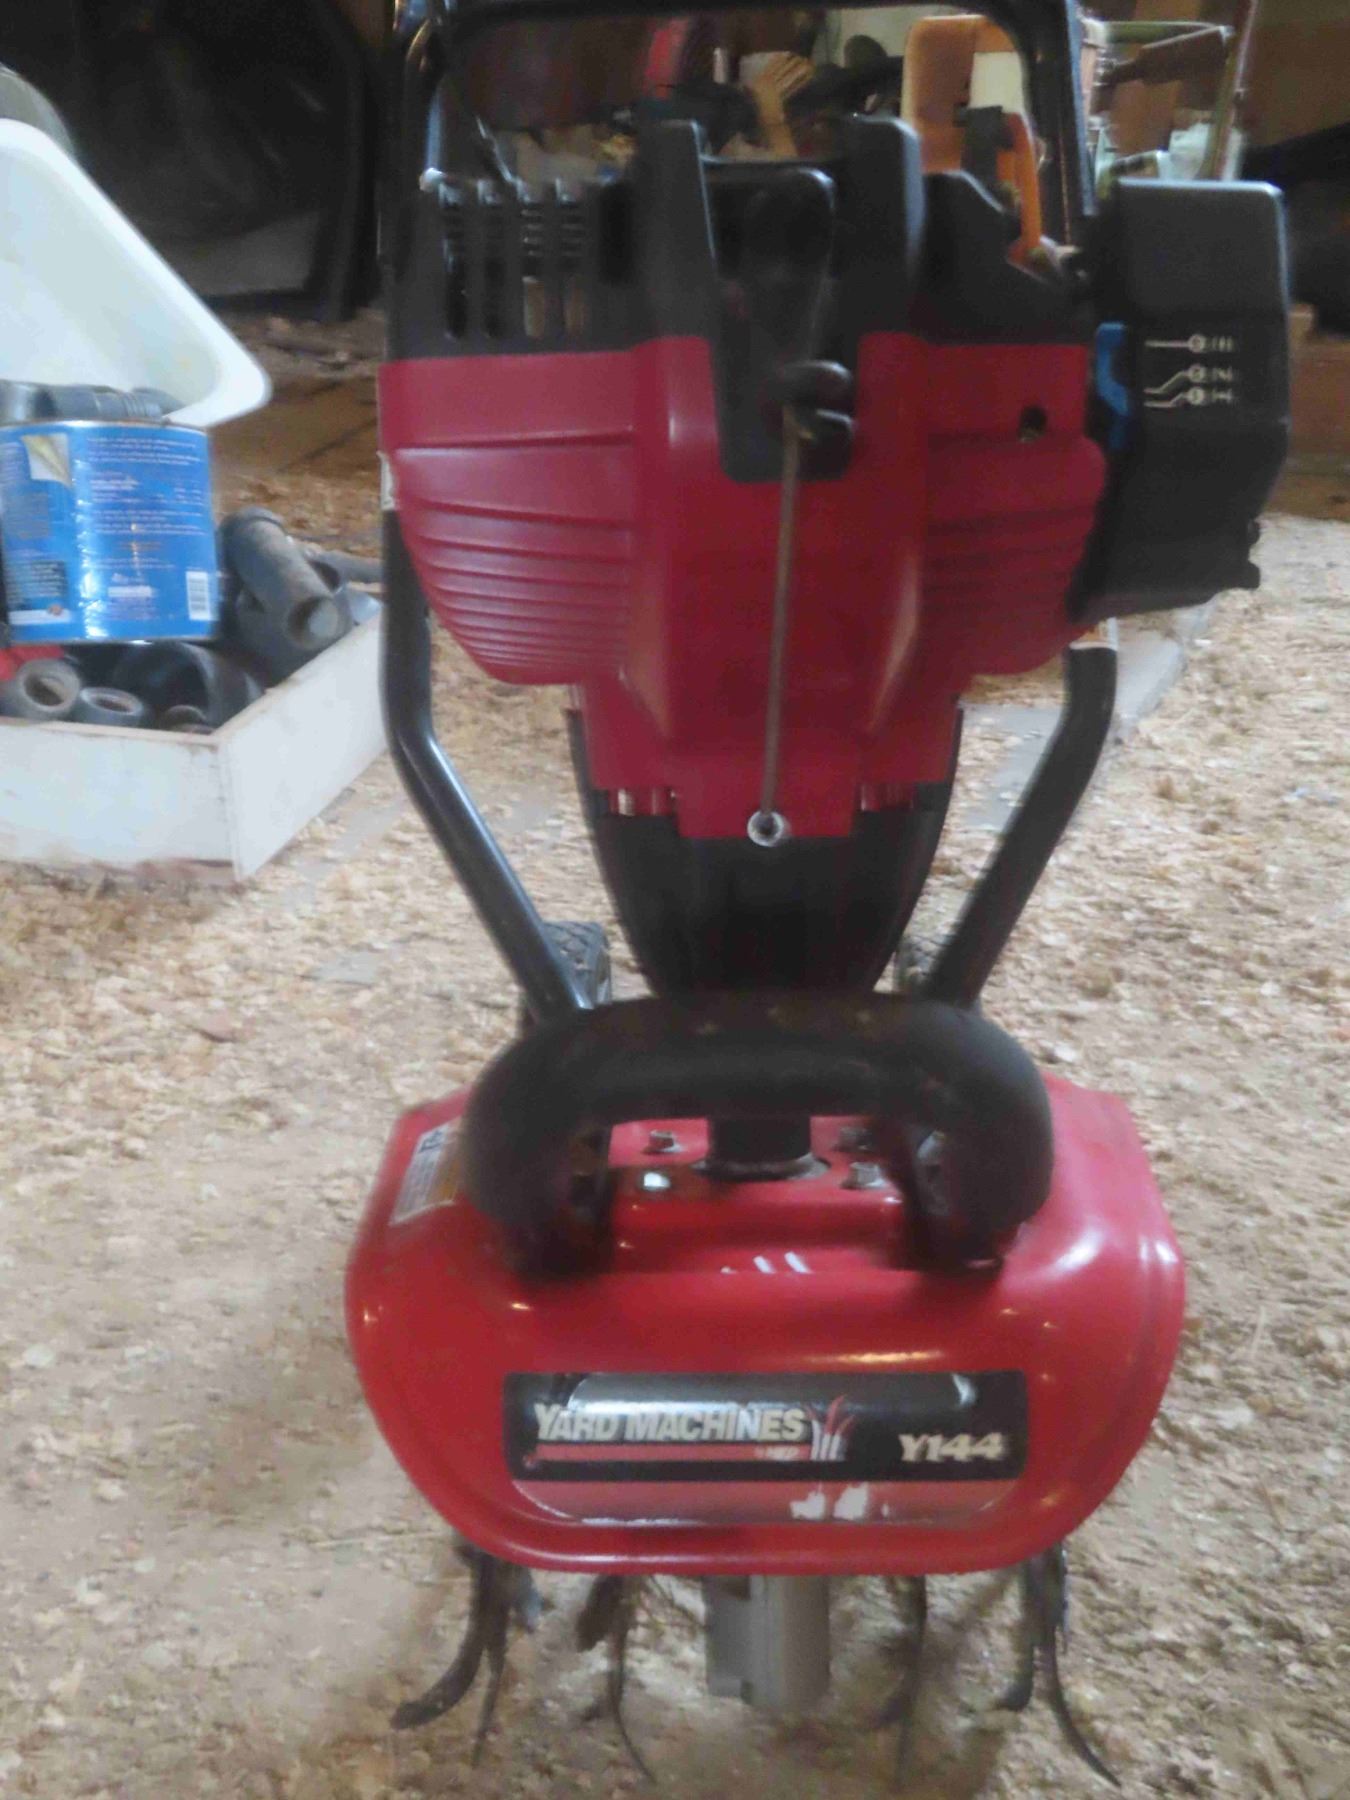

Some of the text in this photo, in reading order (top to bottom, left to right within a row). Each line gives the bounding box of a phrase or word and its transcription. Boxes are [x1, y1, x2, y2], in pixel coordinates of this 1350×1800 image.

[534, 1403, 807, 1442] YARD MACHINES
[899, 1432, 1004, 1463] Y144
